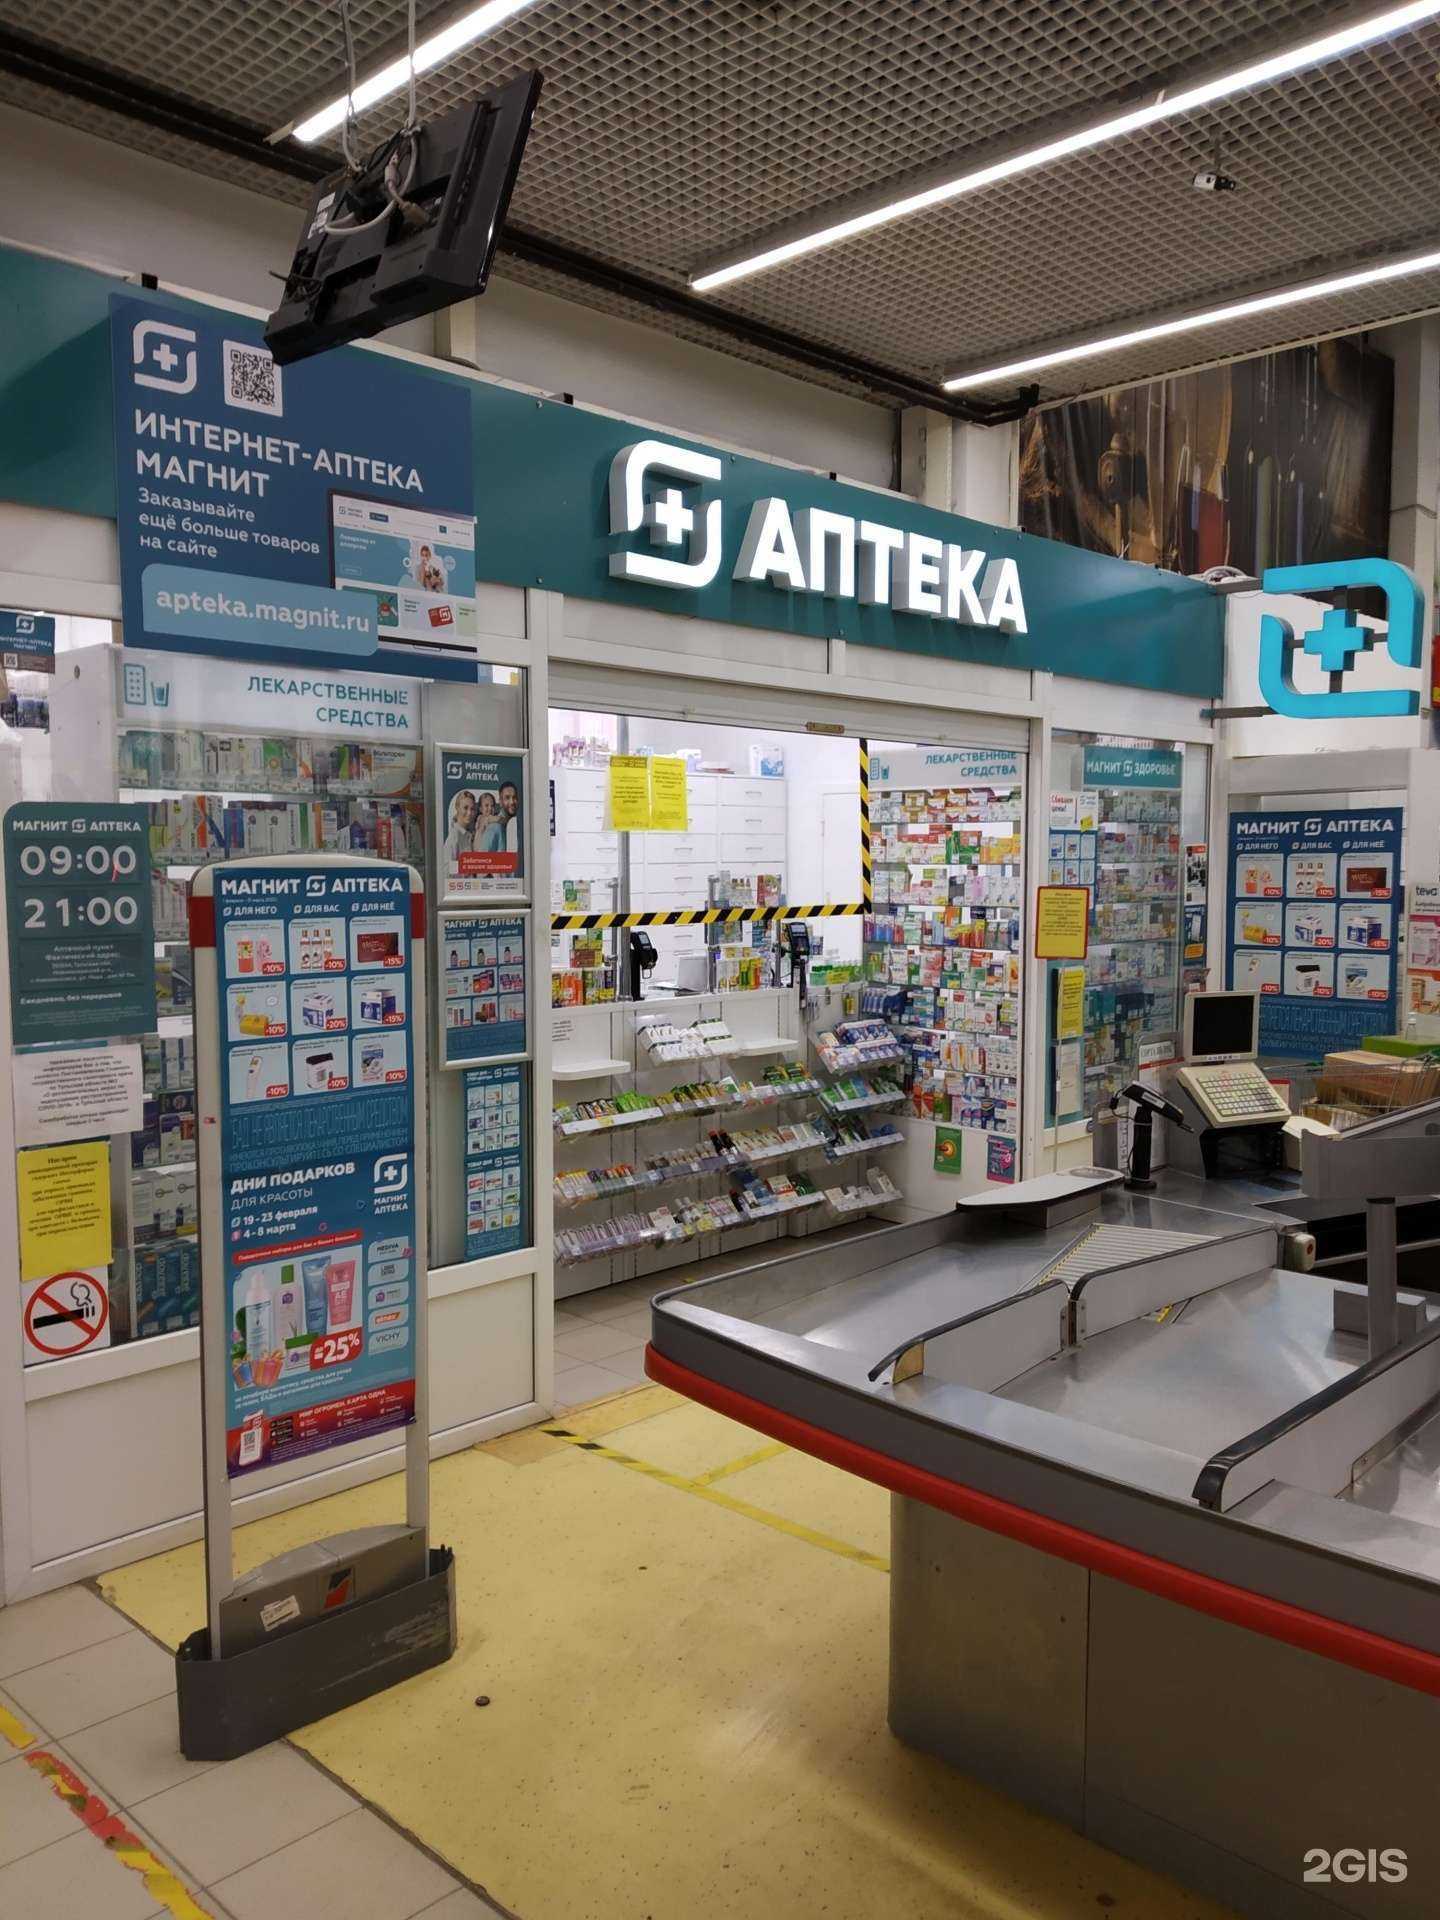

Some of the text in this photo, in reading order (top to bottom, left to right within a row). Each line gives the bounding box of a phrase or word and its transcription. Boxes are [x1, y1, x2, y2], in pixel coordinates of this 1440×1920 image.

[135, 408, 424, 493] ИНТЕРНЕТ-АПТЕКА
[136, 449, 270, 498] МАГНИТ
[138, 487, 256, 523] Заказывайте
[139, 512, 320, 555] ещё больше товаров
[140, 534, 217, 558] на сайте
[738, 497, 1029, 634] АПТЕКА
[156, 589, 370, 633] apteka.magnit.ru
[248, 676, 408, 705] ЛЕКАРСТВЕННЫЕ
[316, 707, 408, 728] СРЕДСТВА
[926, 751, 1017, 765] ЛЕКАРСТВЕННЫЕ
[464, 761, 498, 772] МАГНИТ
[960, 763, 1017, 777] СРЕДСТВА
[1086, 761, 1176, 776] МАГНИТ ЗДОРОВЬЕ
[466, 771, 499, 781] АПТЕКА
[12, 820, 142, 832] МАГНИТ АПТЕКА
[1236, 819, 1394, 835] МАГНИТ АПТЕКА
[1244, 842, 1279, 850] ДЛЯ НЕГО
[20, 845, 137, 876] 09:00
[221, 877, 404, 896] МАГНИТ АПТЕКА
[24, 896, 138, 929] 21:00
[234, 906, 277, 915] ДЛЯ НЕГО
[303, 904, 340, 914] ДЛЯ ВАС
[361, 901, 395, 912] ДЛЯ НЕЁ
[263, 964, 283, 972] -10%
[384, 958, 403, 966] -15%
[265, 1025, 285, 1035] -10%
[326, 1019, 346, 1029] -20%
[386, 1070, 405, 1080] -10%
[328, 1078, 347, 1087] -10%
[267, 1086, 287, 1096] -10%
[230, 1162, 355, 1195] ДНИ ПОДАРКОВ
[231, 1187, 313, 1211] ДЛЯ КРАСОТЫ
[373, 1194, 408, 1206] МАГНИТ
[275, 1205, 318, 1222] февраля
[374, 1204, 408, 1215] АПТЕКА
[266, 1222, 296, 1236] марта
[376, 1332, 400, 1343] VICHY
